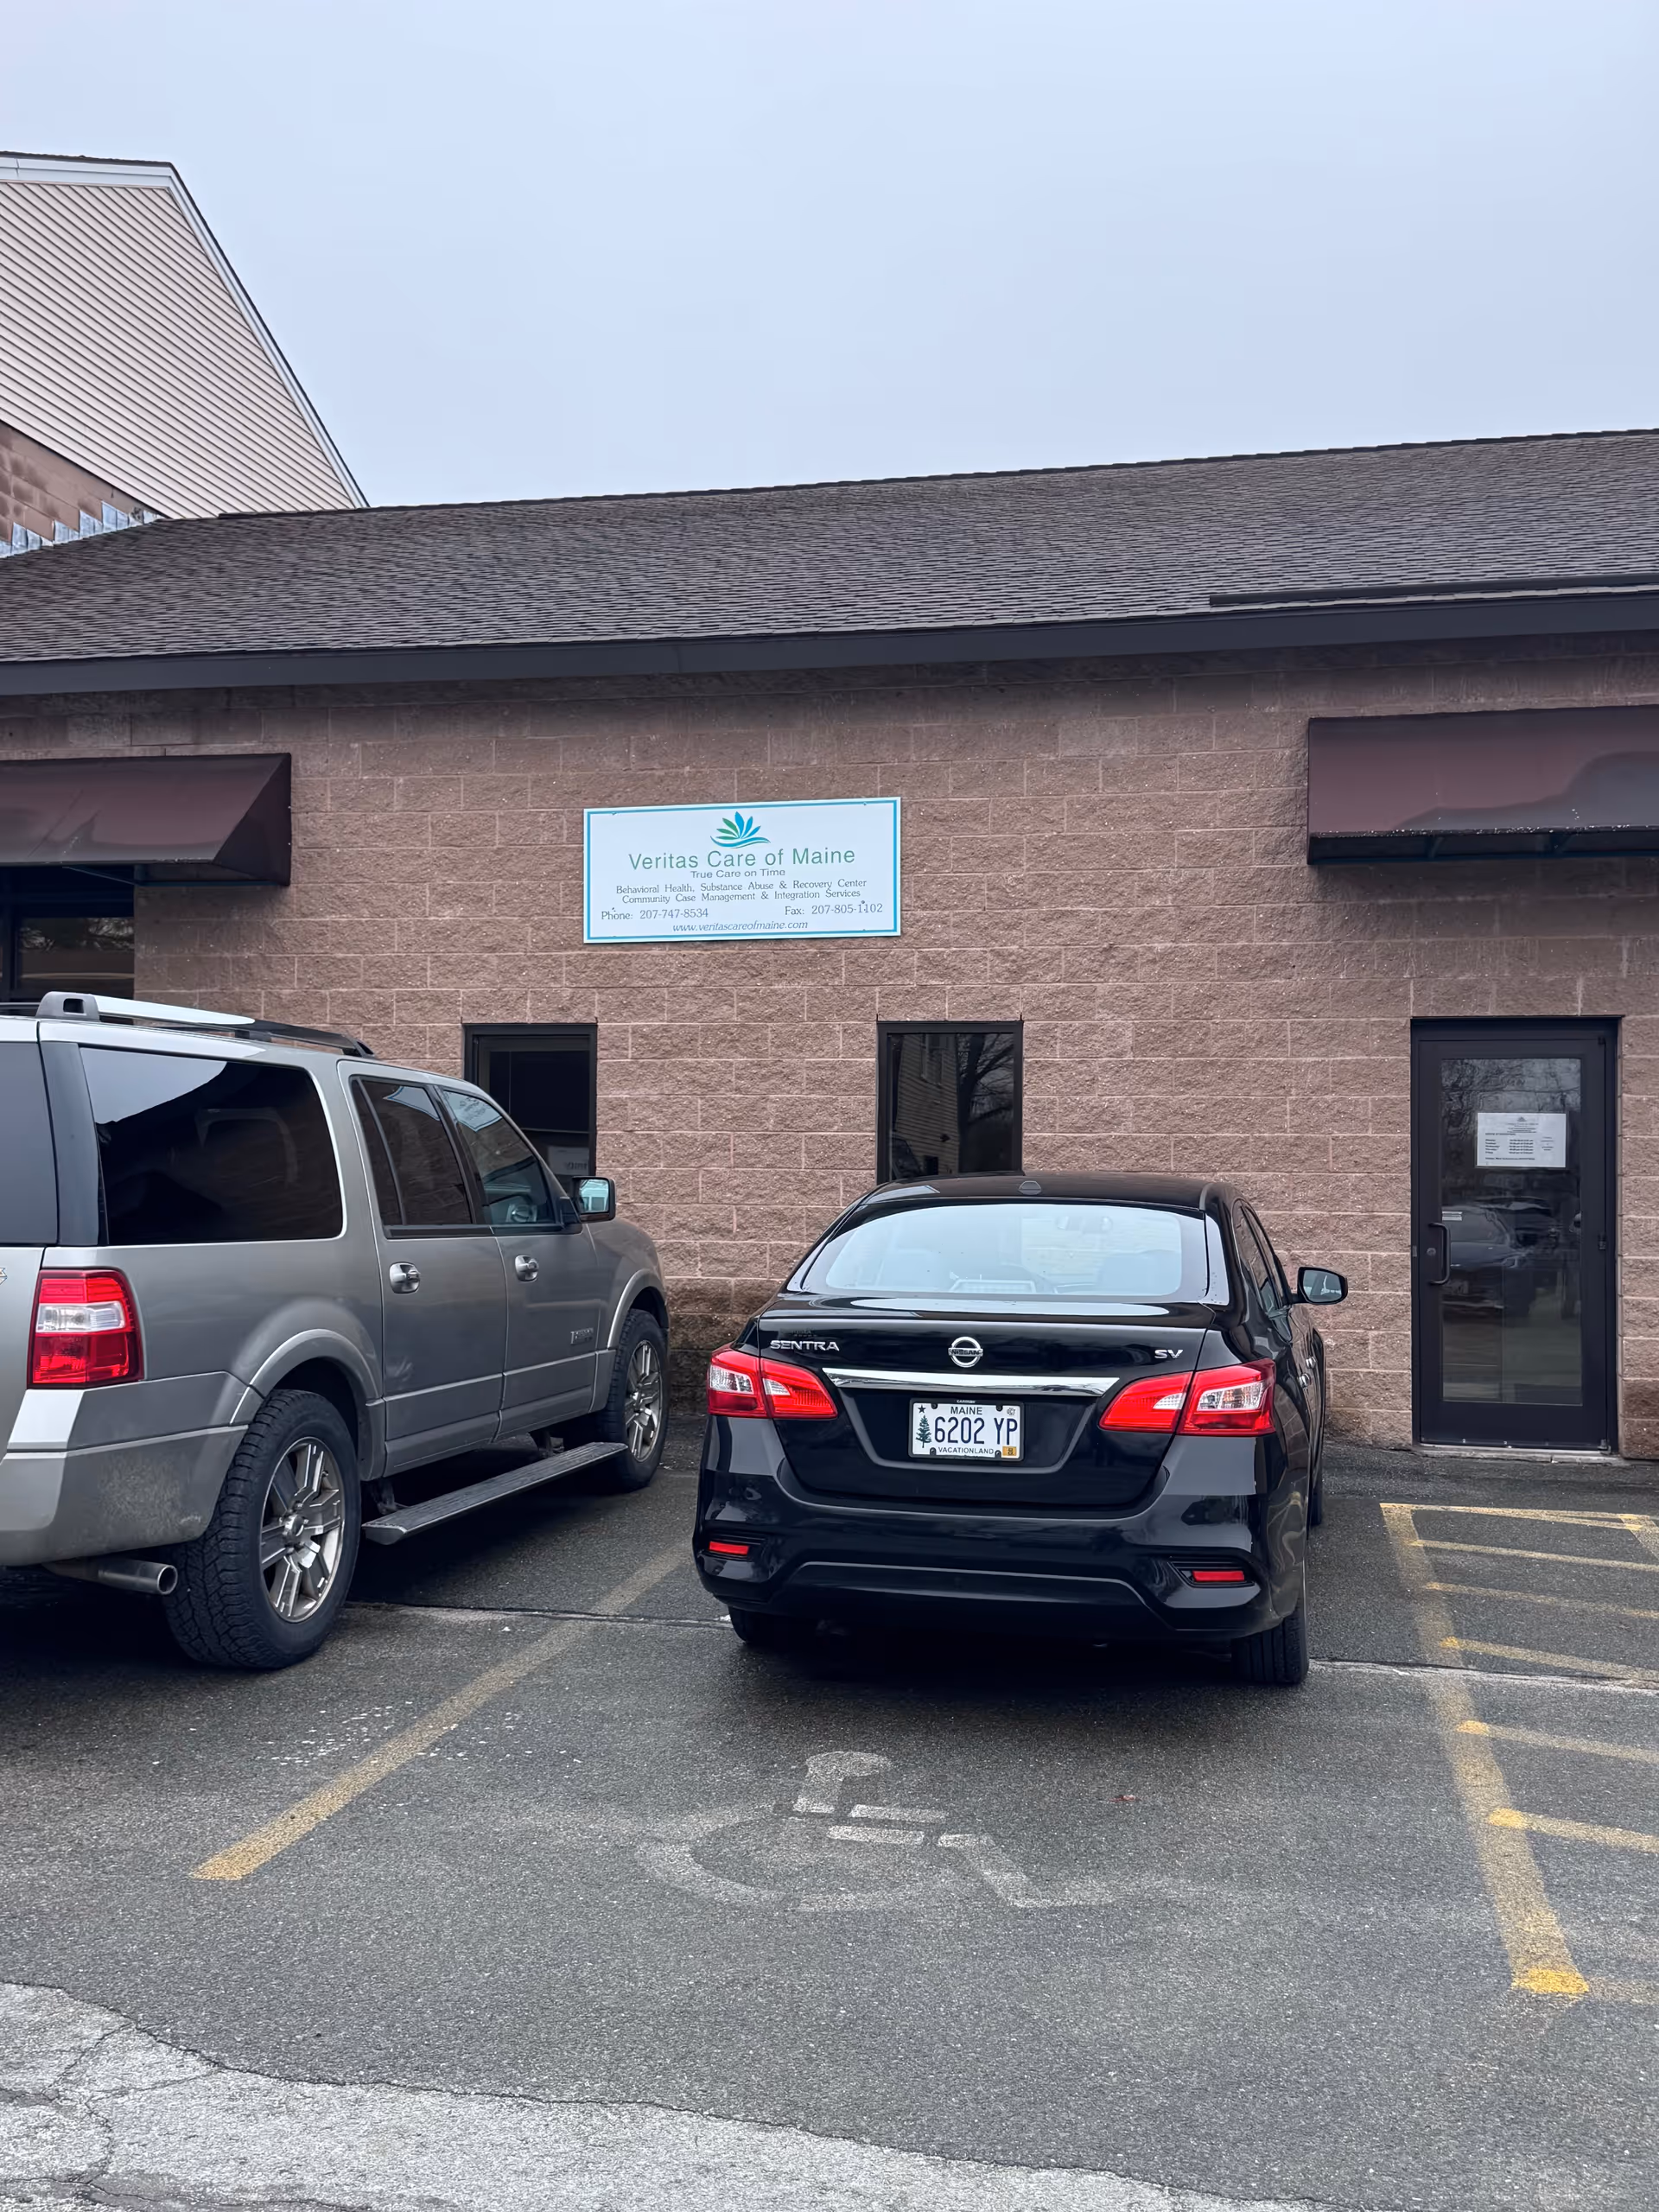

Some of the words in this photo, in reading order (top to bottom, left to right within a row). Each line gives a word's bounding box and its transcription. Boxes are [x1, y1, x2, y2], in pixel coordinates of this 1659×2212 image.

[628, 852, 698, 870] Veritas
[707, 850, 756, 867] Care
[765, 849, 784, 866] of
[792, 847, 855, 865] Maine
[690, 870, 713, 879] True
[715, 869, 741, 878] Care
[616, 884, 659, 894] Behavioral
[664, 883, 695, 893] Health,
[700, 882, 742, 892] Substance
[747, 881, 774, 890] Abuse
[779, 880, 787, 889] &
[793, 880, 832, 890] Recovery
[837, 879, 867, 887] Center
[621, 895, 671, 905] Community
[675, 893, 696, 902] Case
[702, 893, 756, 903] Management
[760, 891, 769, 899] &
[774, 890, 820, 900] Integration
[825, 889, 861, 898] Services
[601, 911, 633, 920] Phone:
[639, 908, 709, 919] 207-747-8534
[785, 906, 804, 916] Fax:
[811, 903, 883, 914] 207-805-1102
[672, 919, 808, 931] www.veritascareofmaine.com
[770, 1339, 840, 1351] SENTRA
[1154, 1349, 1184, 1359] SV
[950, 1406, 983, 1415] MAINE
[934, 1416, 985, 1445] 6202
[994, 1417, 1018, 1446] YP
